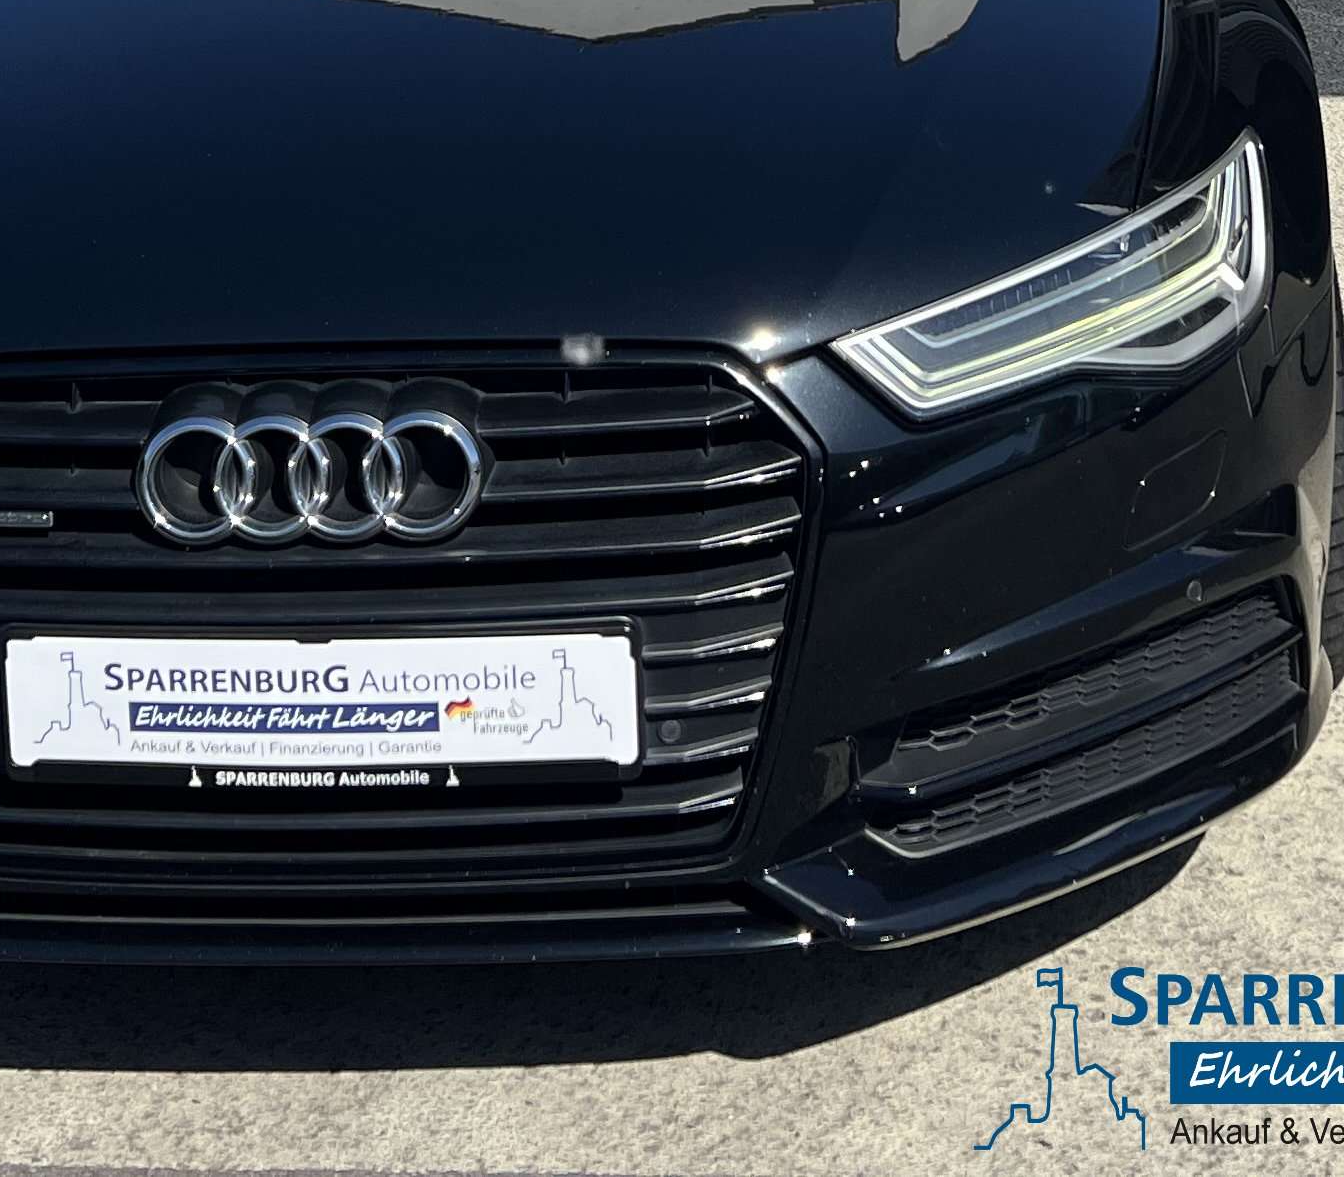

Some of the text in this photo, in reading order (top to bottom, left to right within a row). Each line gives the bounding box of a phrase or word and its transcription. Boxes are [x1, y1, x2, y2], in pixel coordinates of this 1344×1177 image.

[104, 663, 536, 693] SPARRENBURG Automobile
[135, 704, 436, 732] Ehrlichkeit Fährt Länger
[460, 707, 505, 722] geprüfte
[473, 722, 529, 735] Fahrzeuge
[130, 739, 181, 753] Ankauf
[185, 740, 195, 753] &
[200, 740, 256, 755] Verkauf
[269, 740, 364, 757] Finanzierung
[378, 740, 442, 754] Garantie
[215, 771, 430, 787] SPARRENBURG Automobile
